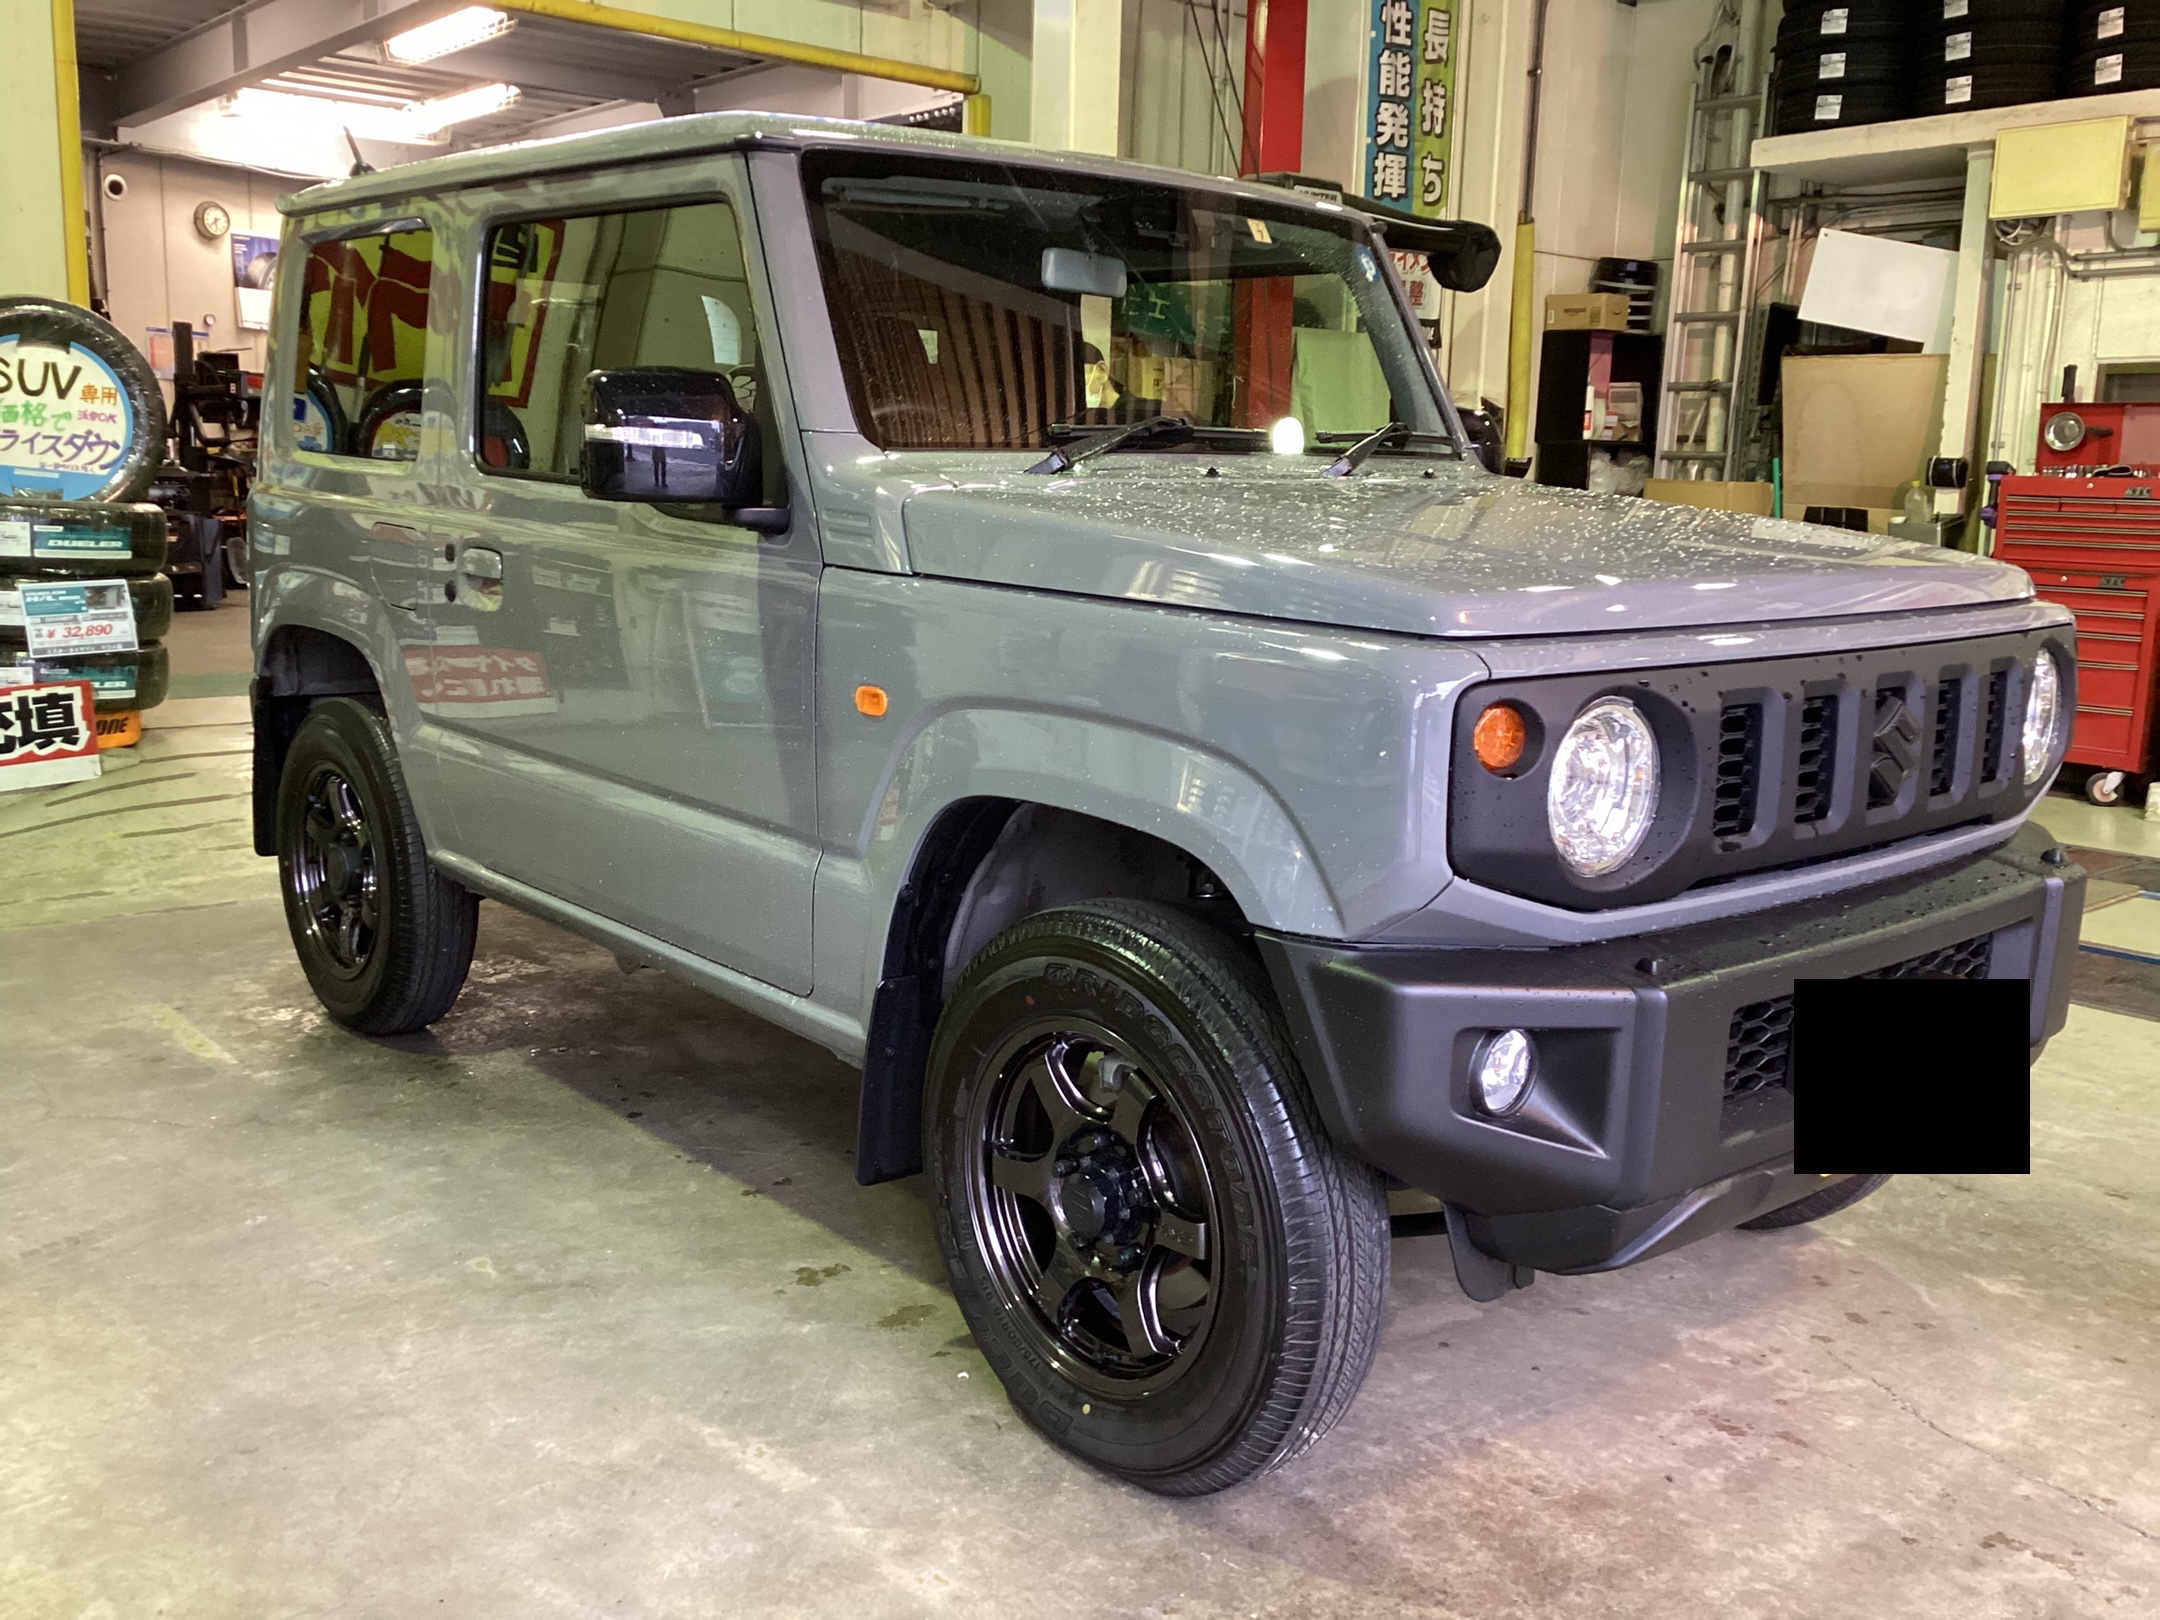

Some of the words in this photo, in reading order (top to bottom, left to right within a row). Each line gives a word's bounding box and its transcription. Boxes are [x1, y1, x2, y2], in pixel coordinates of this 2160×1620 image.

[1374, 0, 1412, 199] 性能発揮
[1421, 8, 1450, 204] 長持ち
[0, 357, 82, 400] SUV
[80, 384, 119, 406] 専用
[2124, 486, 2152, 497] KTC
[62, 623, 113, 640] 32,890
[0, 691, 81, 754] 填
